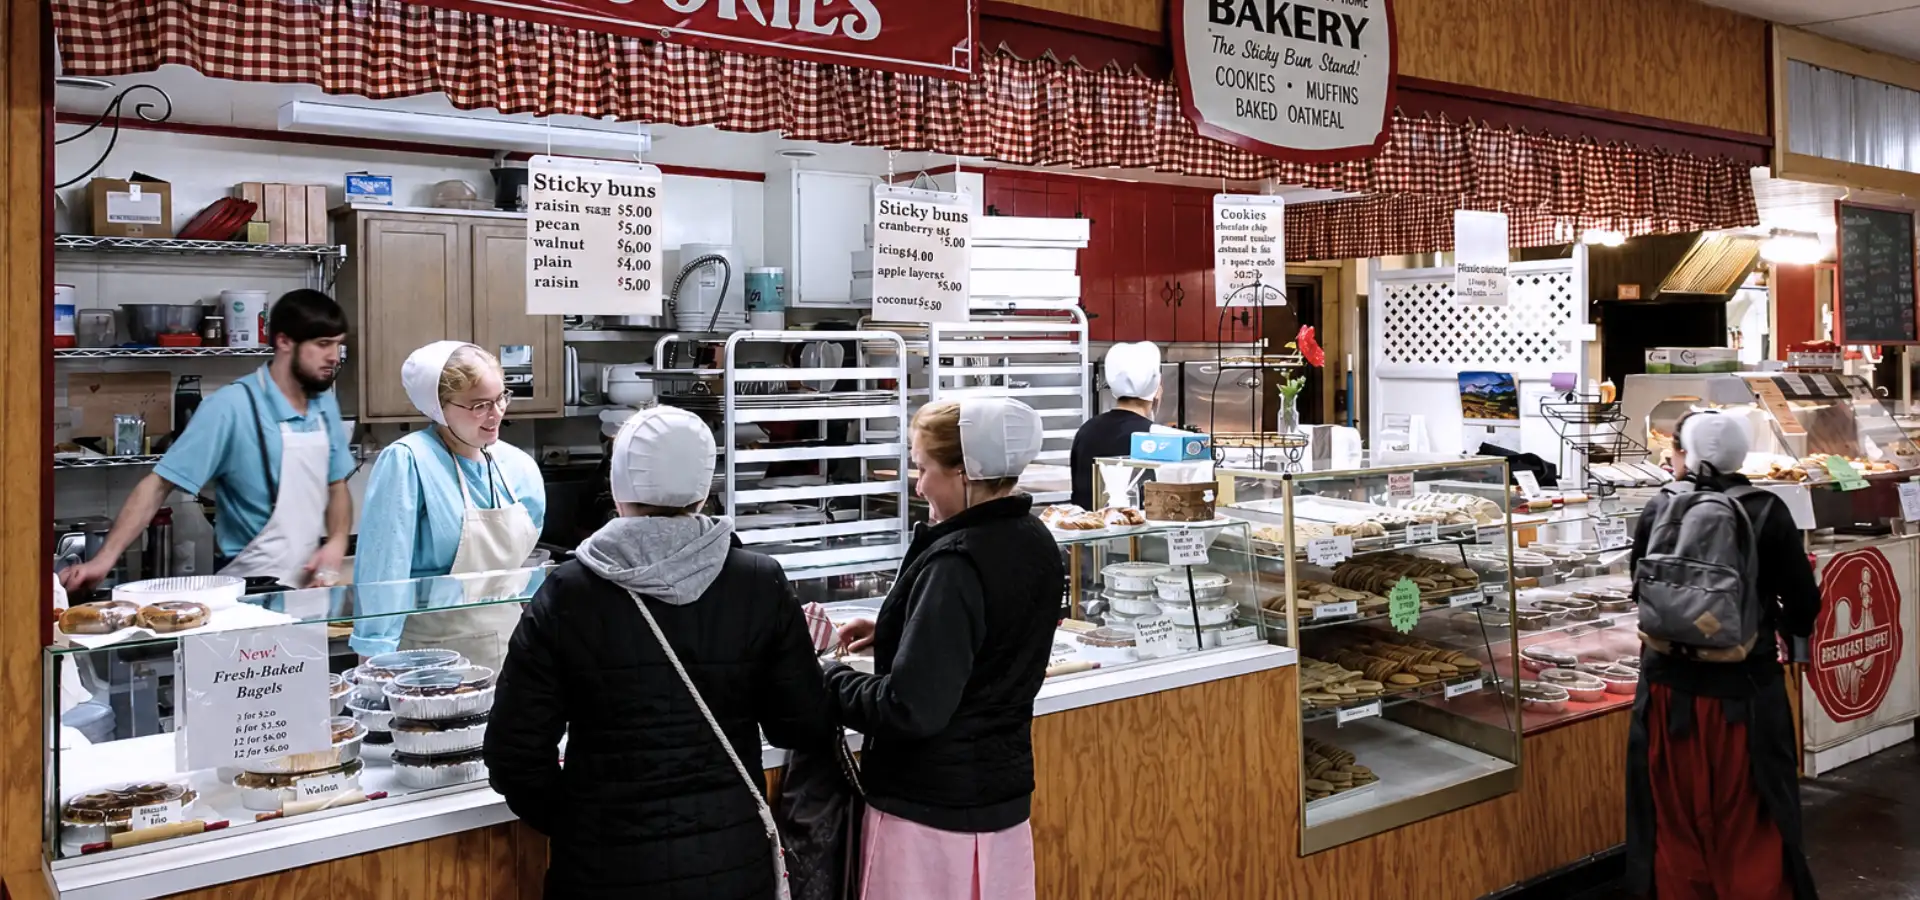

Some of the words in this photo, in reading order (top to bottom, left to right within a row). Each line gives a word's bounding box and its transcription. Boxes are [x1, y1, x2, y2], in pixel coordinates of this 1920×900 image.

[1208, 0, 1369, 50] BAKERY
[1212, 35, 1236, 56] The
[1242, 40, 1279, 69] Sticky
[1284, 48, 1313, 69] Bun
[1319, 53, 1361, 76] Stand!
[1215, 66, 1276, 94] COOKIES
[1306, 80, 1359, 105] MUFFINS
[1236, 97, 1277, 121] BAKED
[1287, 105, 1345, 130] OATMEAL
[534, 173, 602, 198] Sticky
[608, 179, 657, 199] buns
[535, 200, 580, 213] raisin
[617, 204, 652, 218] $5.00
[879, 200, 928, 221] Sticky
[932, 206, 968, 223] buns
[1221, 208, 1266, 220] Cookies
[535, 219, 580, 231] pecan
[618, 220, 652, 236] $5.00
[878, 221, 934, 236] cranberry
[534, 237, 585, 250] walnut
[617, 238, 652, 253] $6.00
[533, 255, 572, 270] plain
[617, 257, 651, 271] $4.00
[878, 266, 906, 278] apple
[534, 276, 579, 288] raisin
[618, 277, 651, 291] $5.00
[239, 645, 277, 662] New!
[213, 661, 305, 684] Fresh-Baked
[236, 682, 283, 699] Bagels
